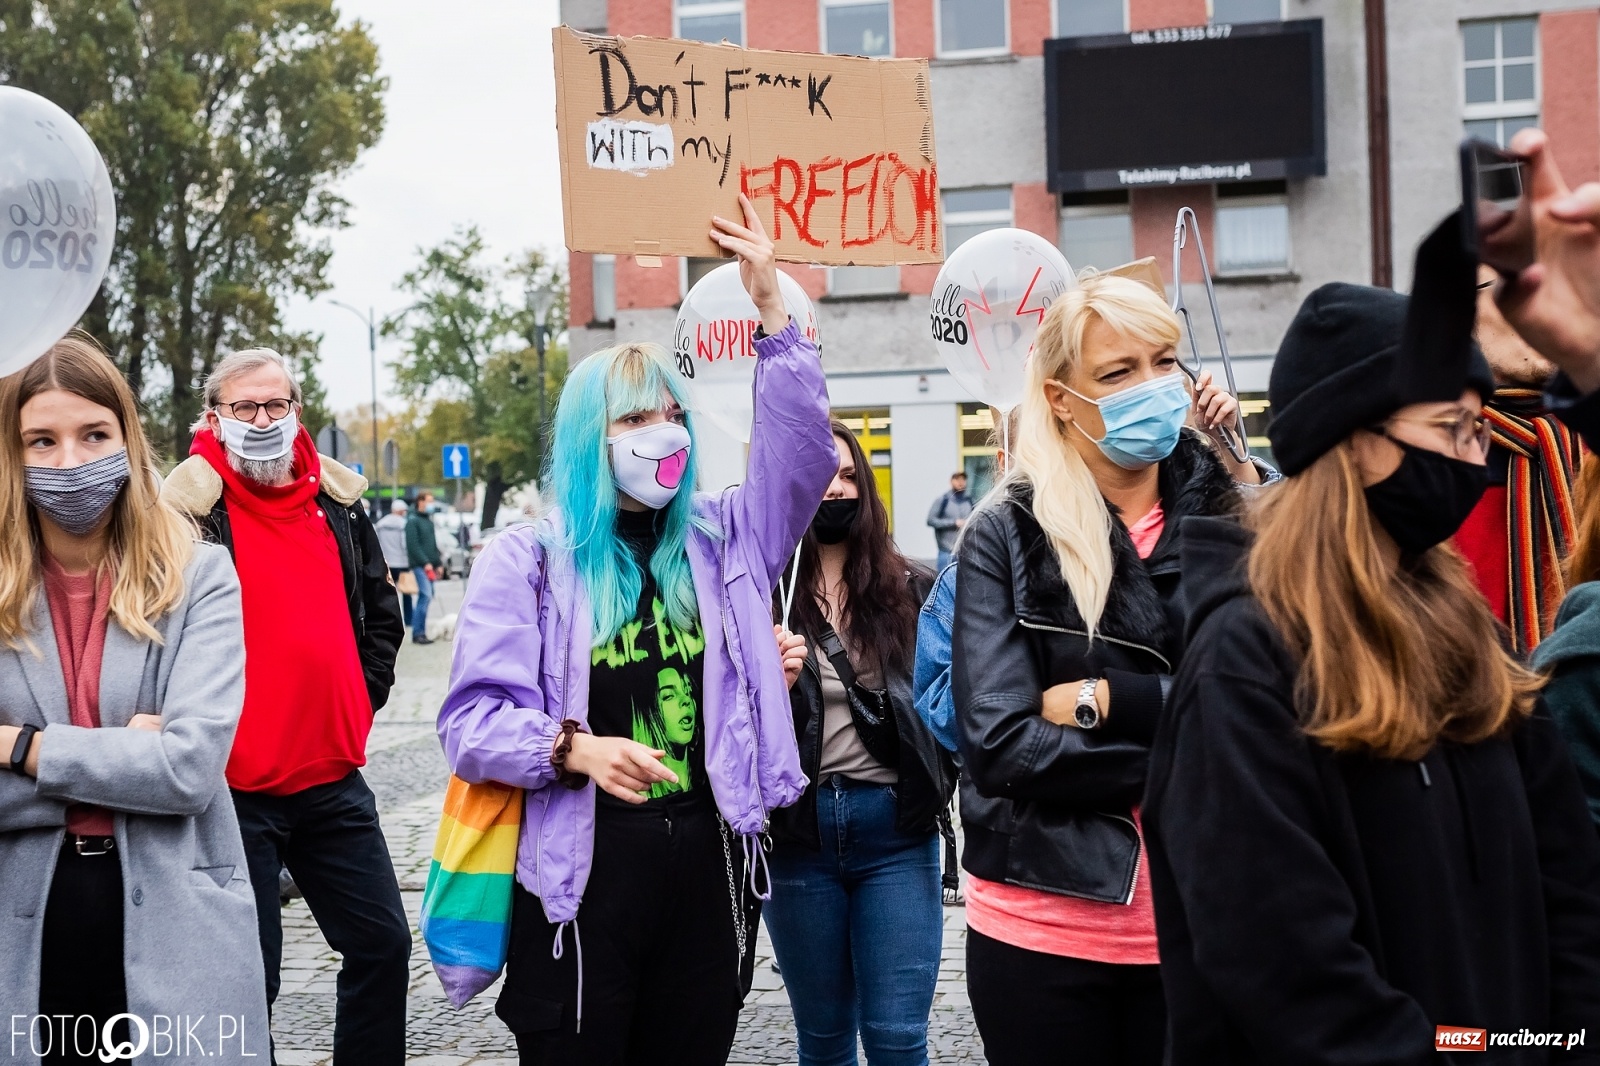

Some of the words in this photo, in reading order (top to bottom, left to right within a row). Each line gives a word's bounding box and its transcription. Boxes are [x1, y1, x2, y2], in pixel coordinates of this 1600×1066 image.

[588, 46, 707, 120] Don't
[681, 134, 732, 189] my
[739, 151, 939, 254] FREEDOM
[674, 318, 690, 352] llo
[674, 350, 695, 380] 20
